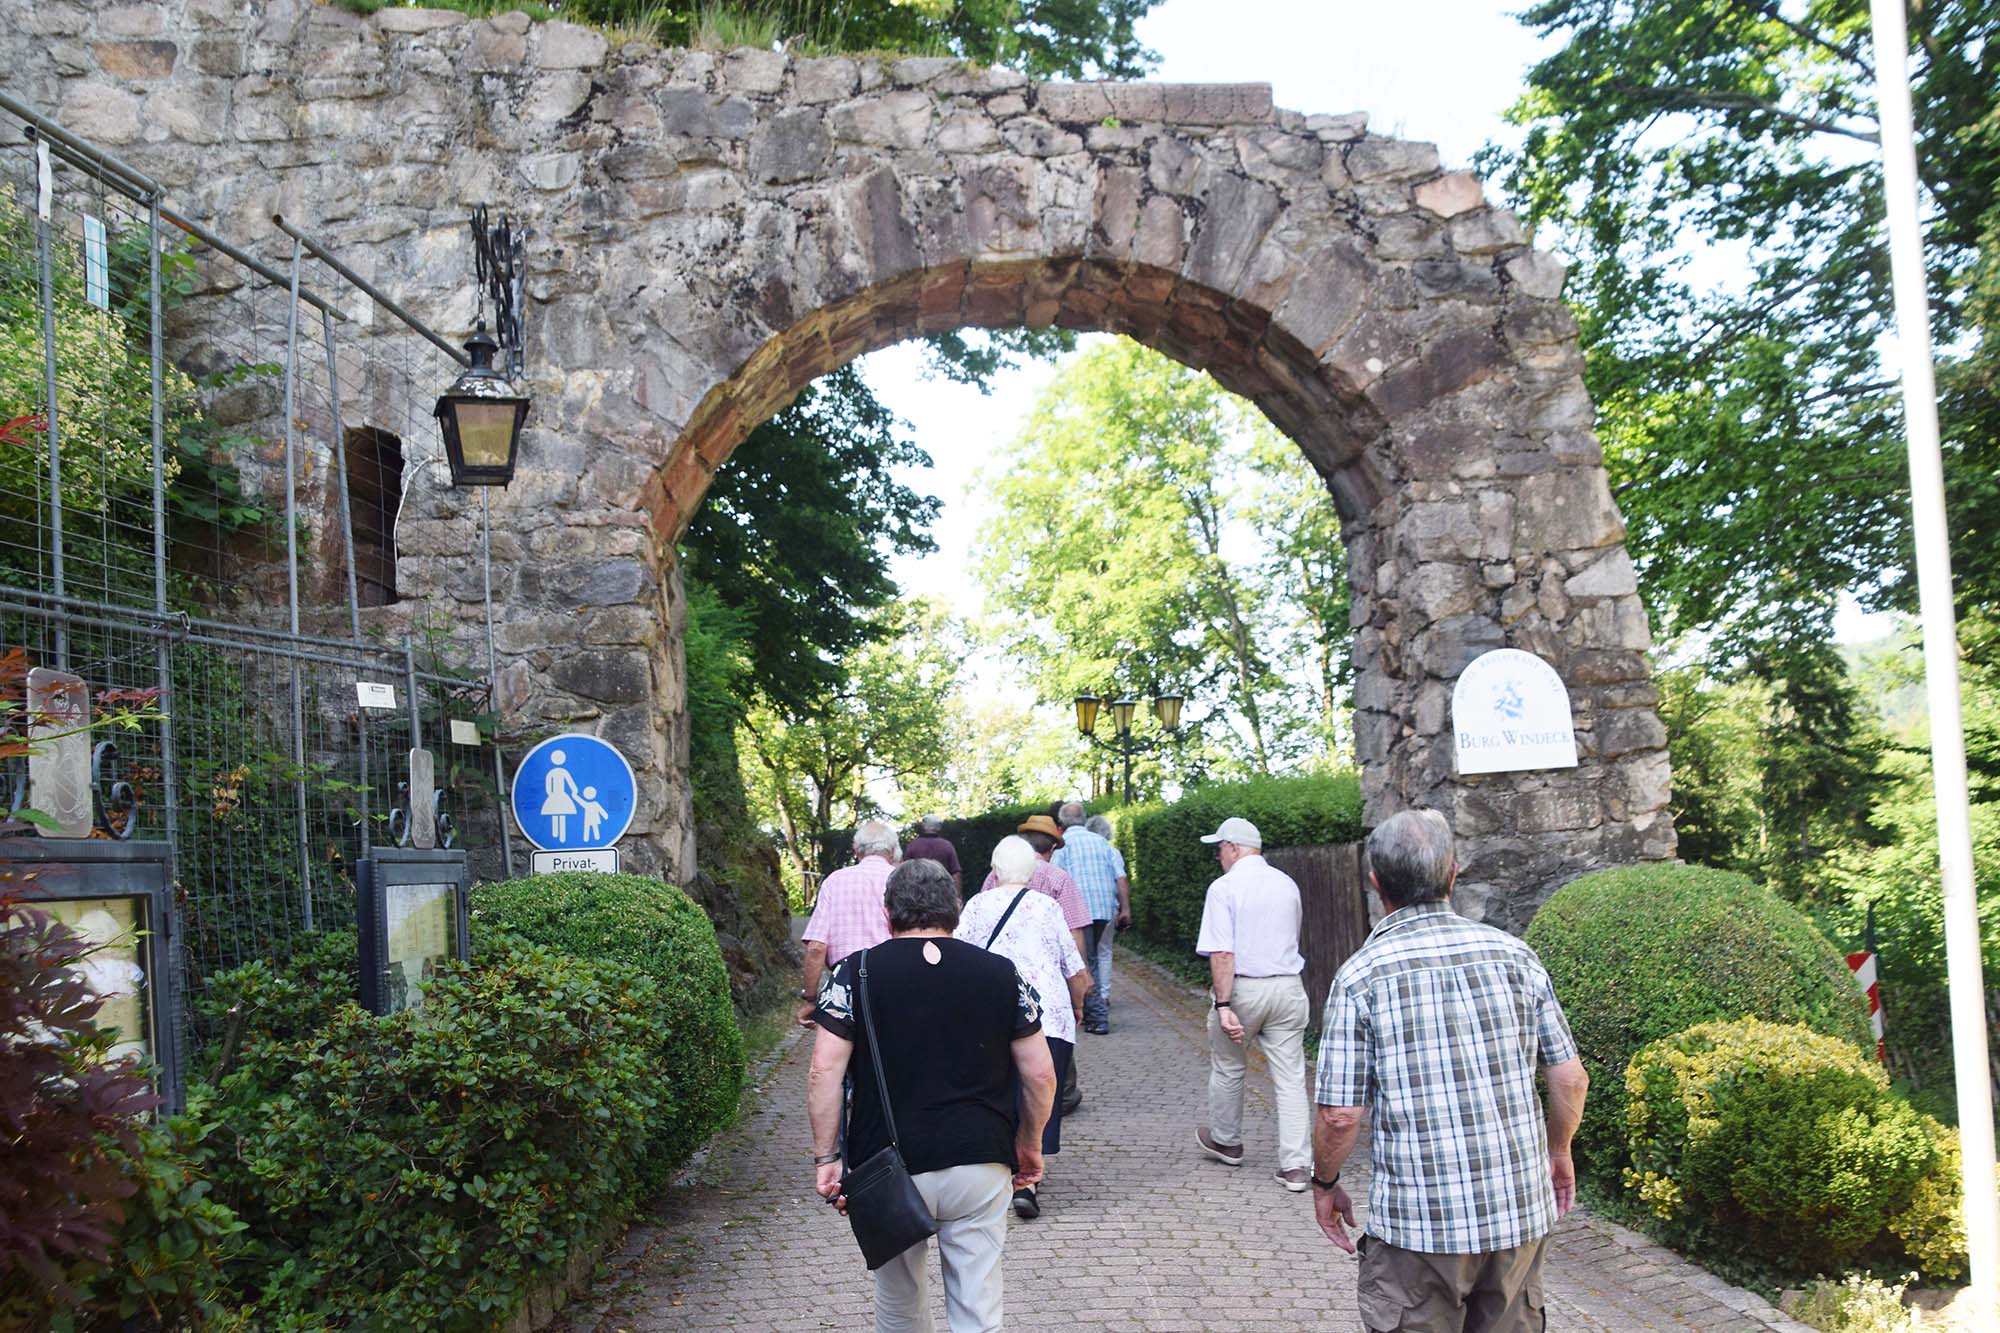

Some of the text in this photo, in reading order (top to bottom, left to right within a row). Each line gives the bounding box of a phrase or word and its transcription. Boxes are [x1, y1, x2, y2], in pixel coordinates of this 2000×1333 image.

[1460, 730, 1570, 749] BURG WINDECK
[553, 857, 596, 869] Privat-
